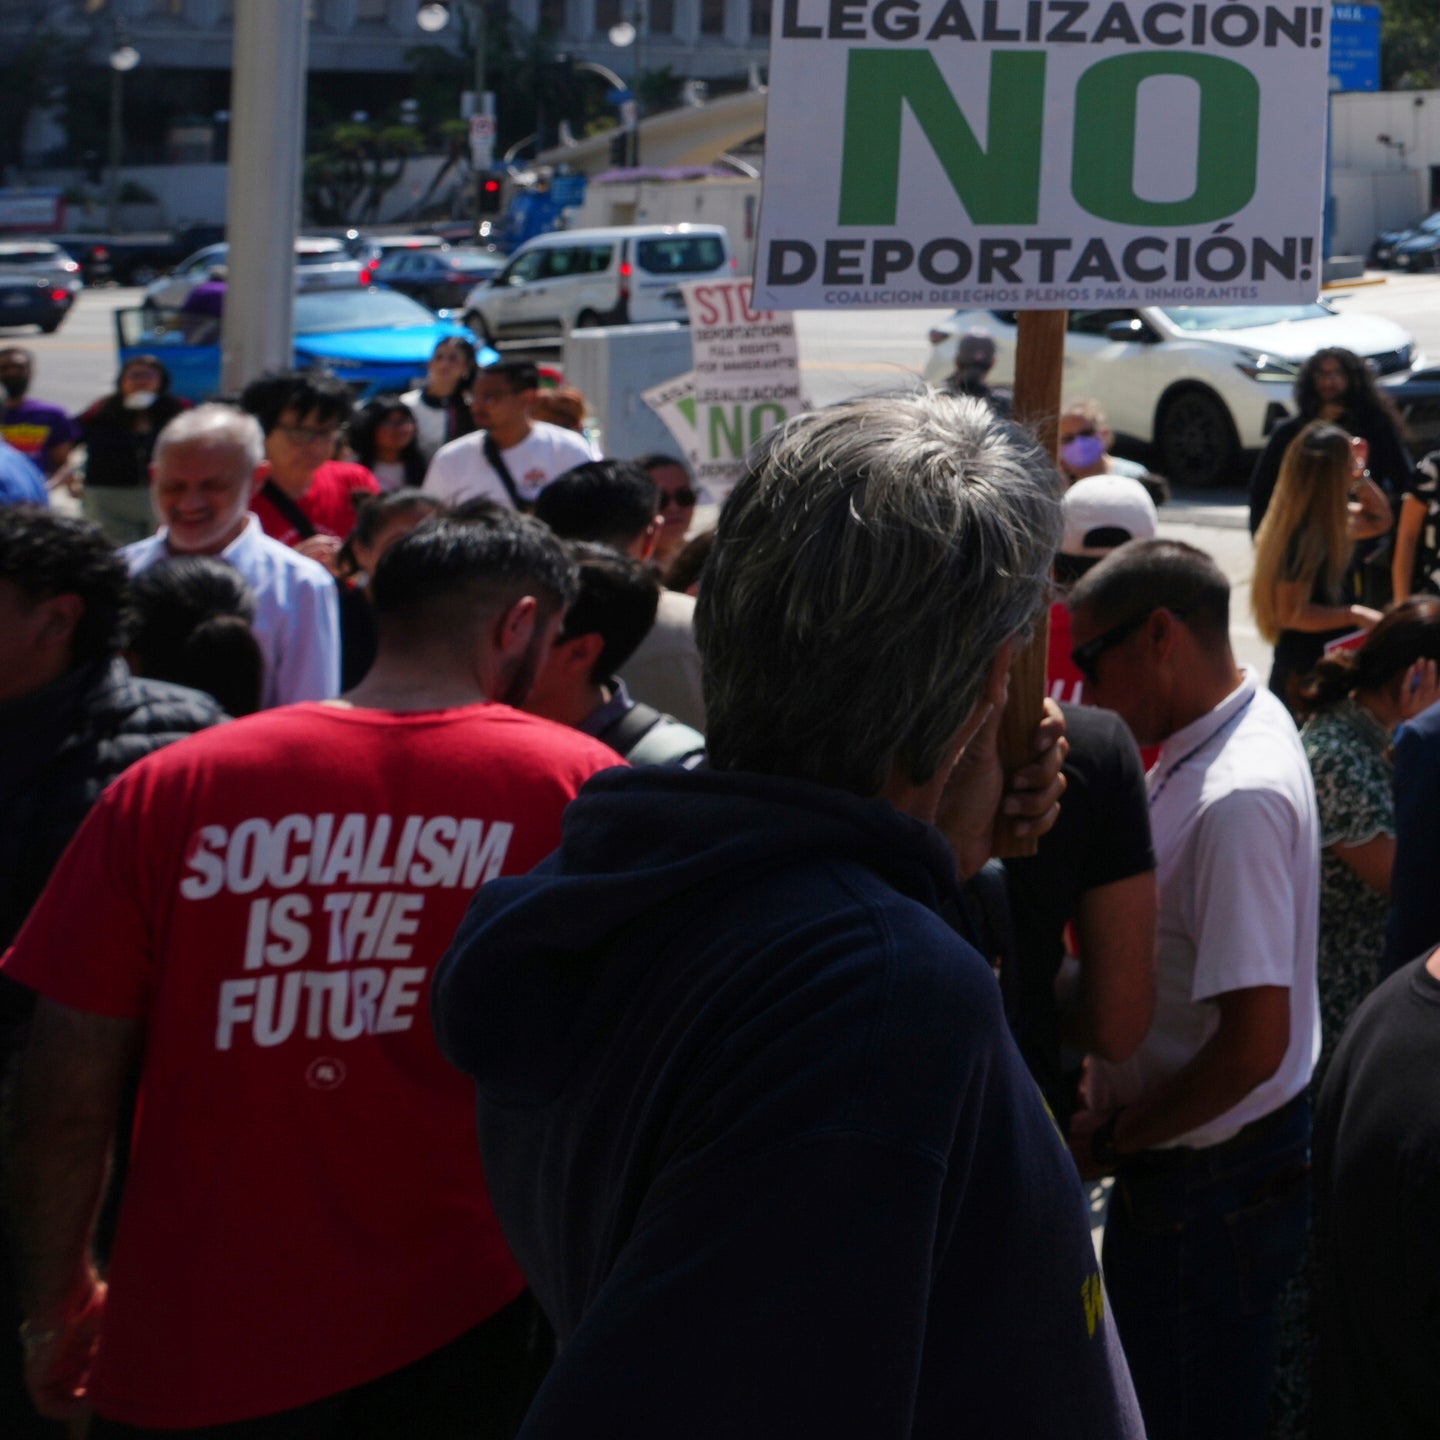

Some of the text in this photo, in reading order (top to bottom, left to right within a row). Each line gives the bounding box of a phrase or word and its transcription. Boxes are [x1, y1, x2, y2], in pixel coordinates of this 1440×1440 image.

[838, 47, 1261, 227] NO
[766, 223, 1314, 286] DEPORTACIÓN!
[824, 289, 923, 304] COALICION
[929, 288, 1020, 304] DERECHOS
[1024, 287, 1091, 303] PLENOS
[1095, 286, 1140, 302] PARA
[180, 813, 514, 901] SOCIALISM
[243, 892, 424, 970] IS THE
[216, 967, 426, 1051] FUTURE
